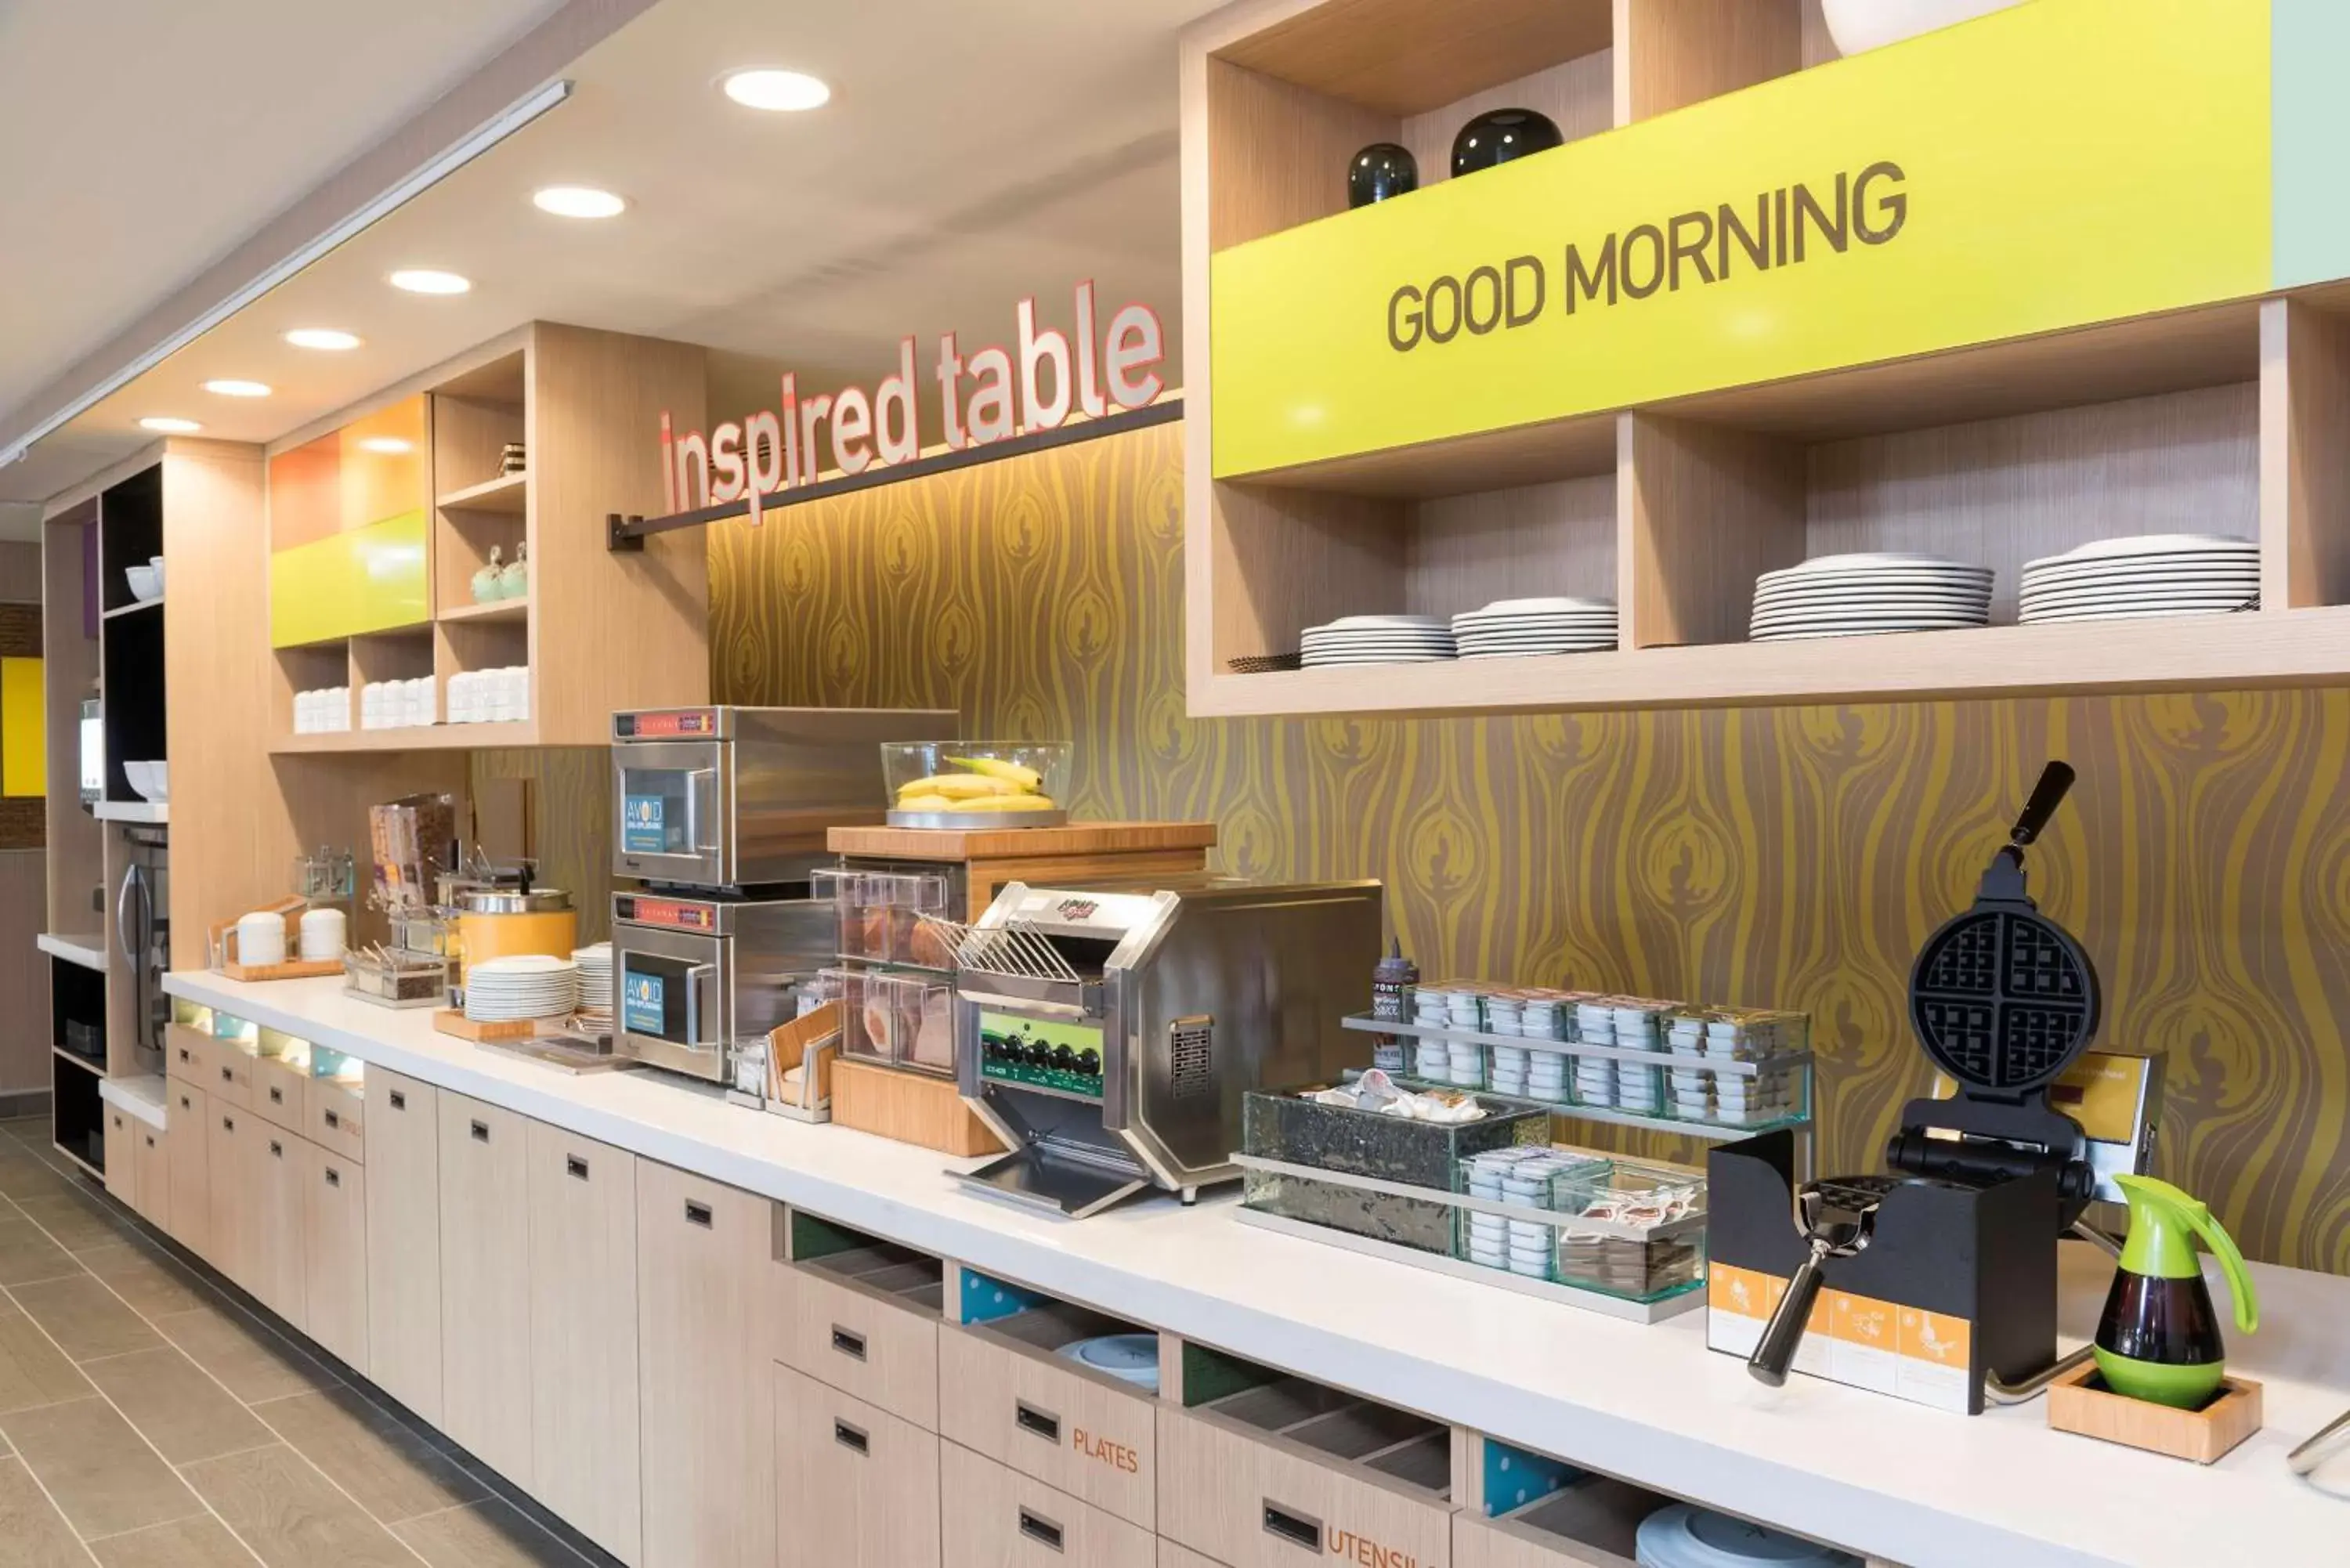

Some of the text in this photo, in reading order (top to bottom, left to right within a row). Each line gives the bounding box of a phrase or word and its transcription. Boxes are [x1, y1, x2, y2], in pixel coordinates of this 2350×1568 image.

[1387, 161, 1907, 352] GOOD MORNING
[660, 279, 1165, 526] inspired table
[627, 977, 663, 1003] AVOID
[1073, 1428, 1137, 1473] PLATES
[1328, 1525, 1437, 1568] UTENSI
